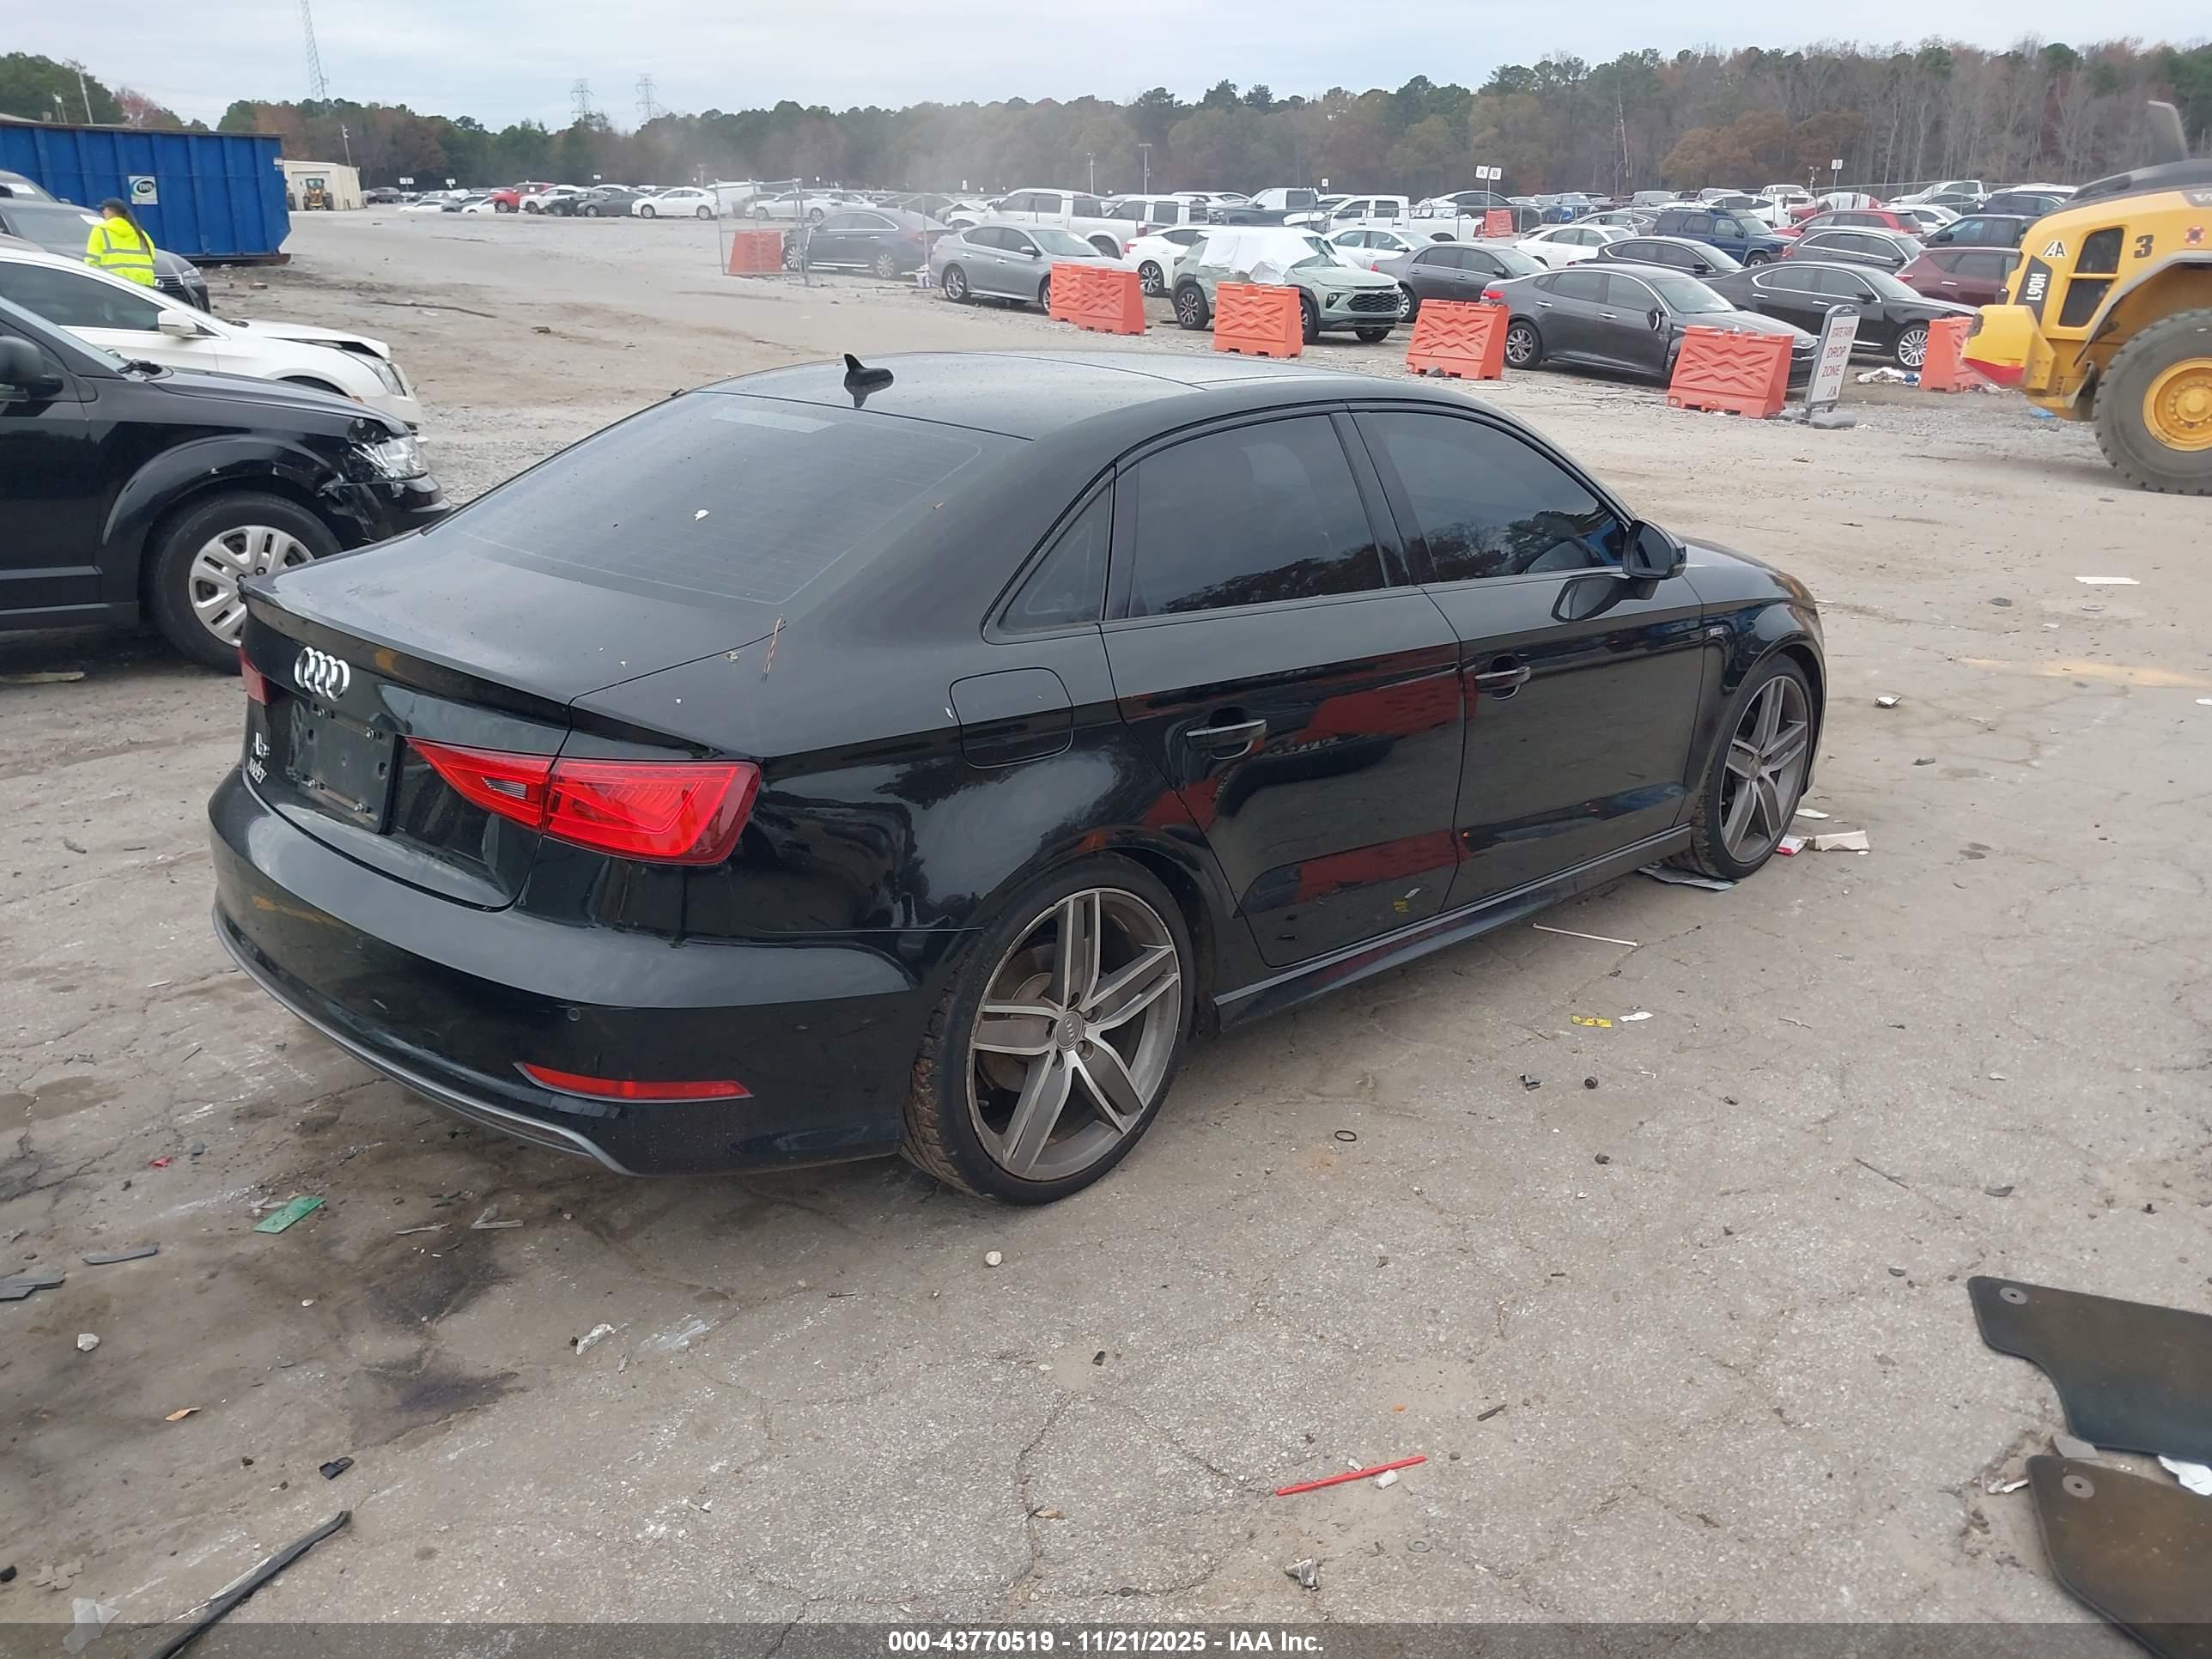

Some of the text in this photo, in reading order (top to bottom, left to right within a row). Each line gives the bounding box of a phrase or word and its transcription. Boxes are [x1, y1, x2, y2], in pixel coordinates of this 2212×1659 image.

[2134, 234, 2154, 258] 3
[2026, 273, 2046, 301] L90H
[1826, 345, 1846, 358] DROP
[1821, 364, 1841, 377] ZONE
